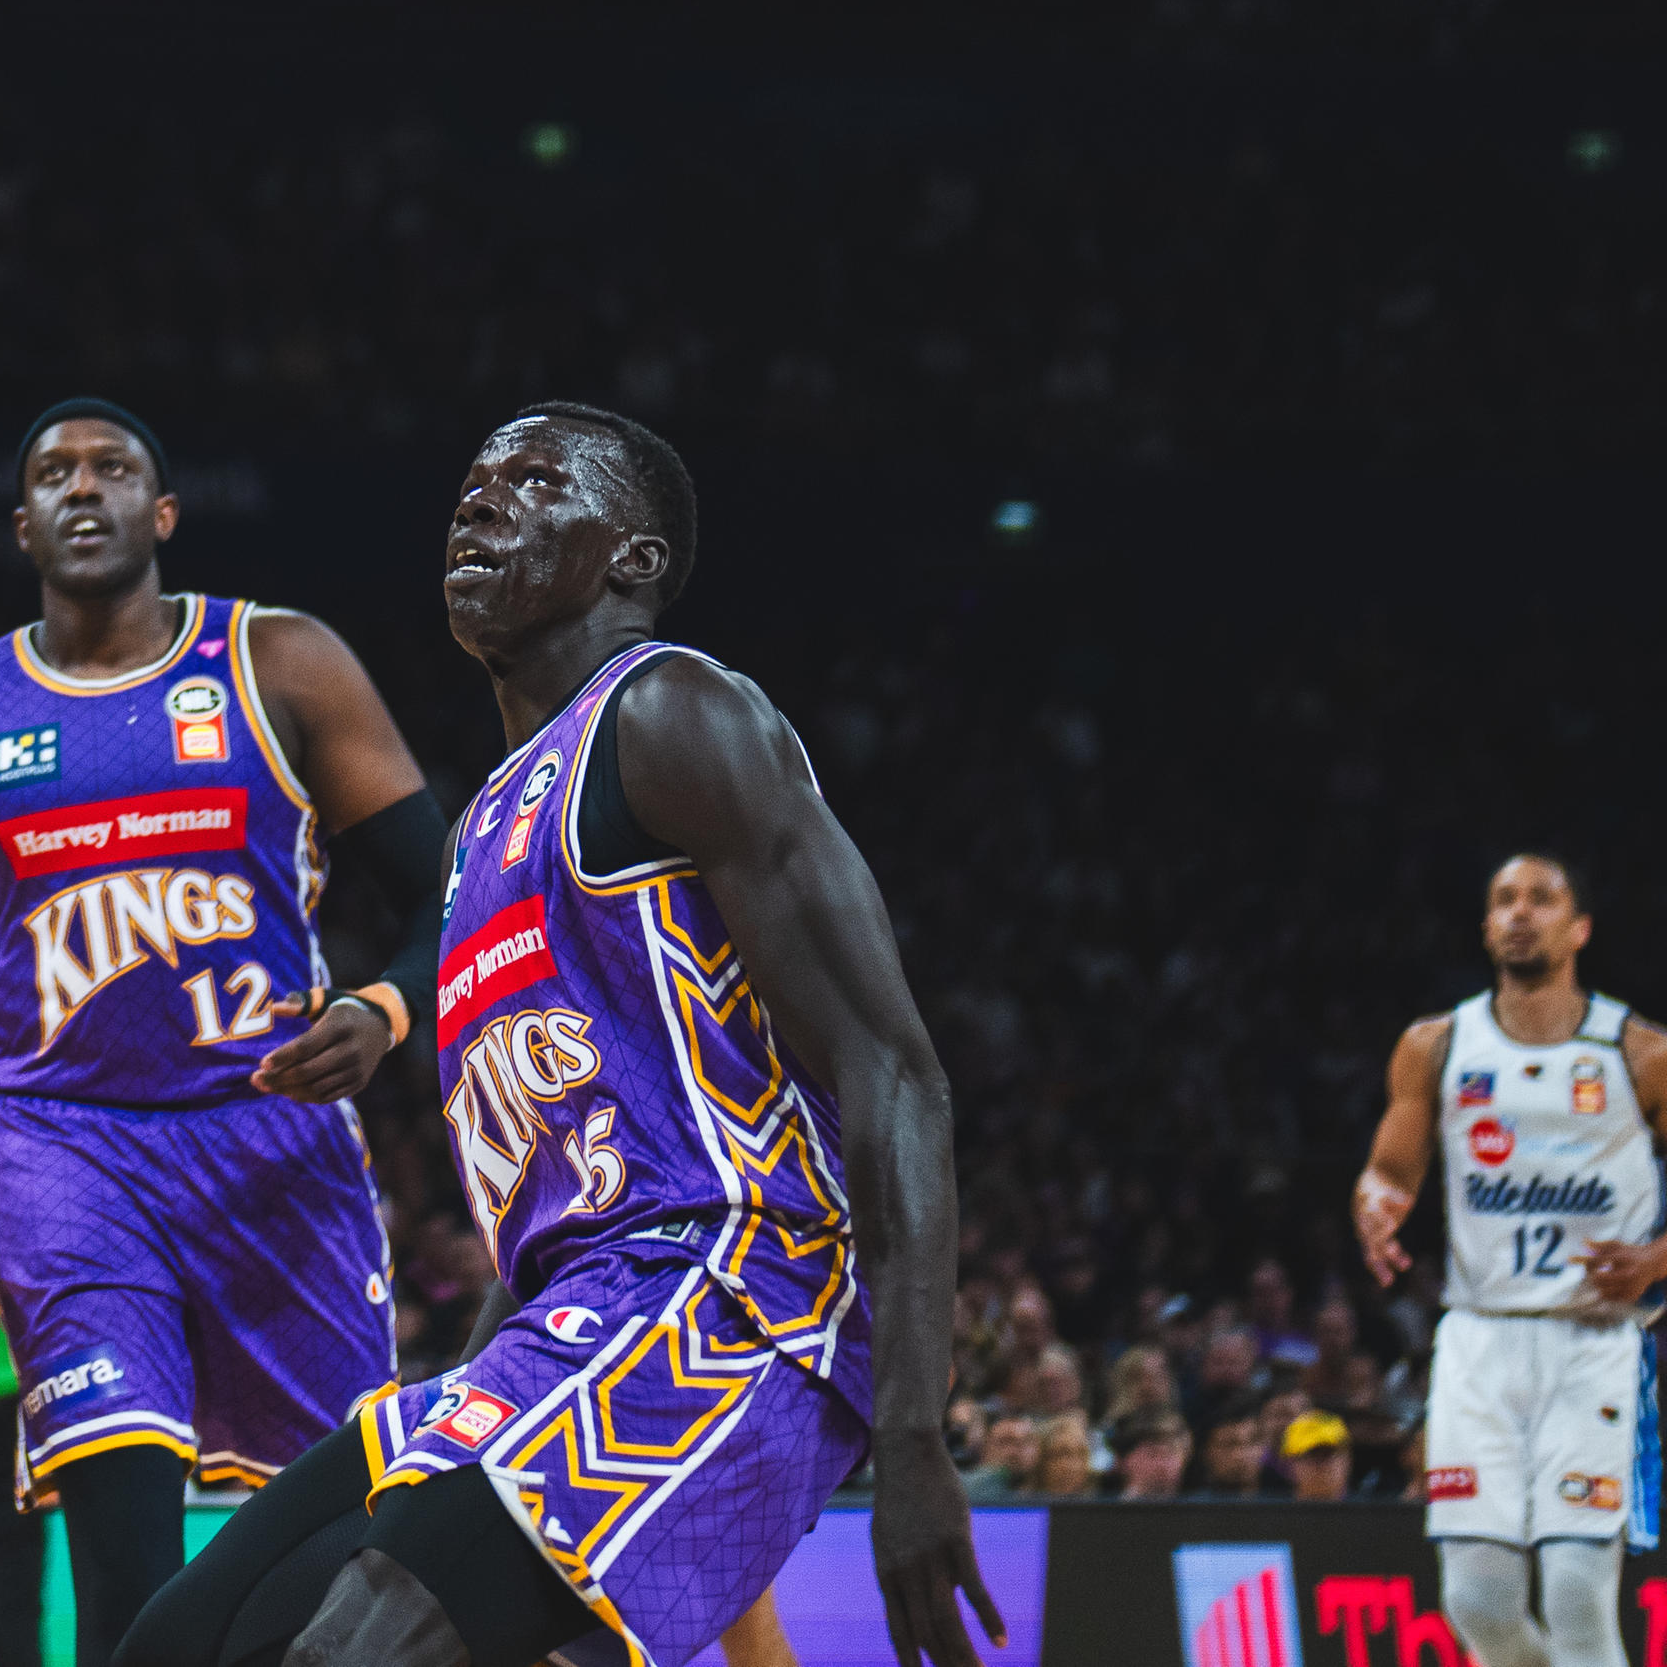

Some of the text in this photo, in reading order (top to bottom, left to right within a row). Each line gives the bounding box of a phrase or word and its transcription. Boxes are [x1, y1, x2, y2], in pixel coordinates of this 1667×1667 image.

[12, 808, 232, 858] Harvey Norman
[22, 867, 258, 1058] KINGS
[181, 961, 275, 1046] 12
[438, 926, 546, 1020] Harvey Norman
[443, 1007, 602, 1278] KINGS
[559, 1105, 626, 1219] 15
[1514, 1223, 1565, 1278] 12
